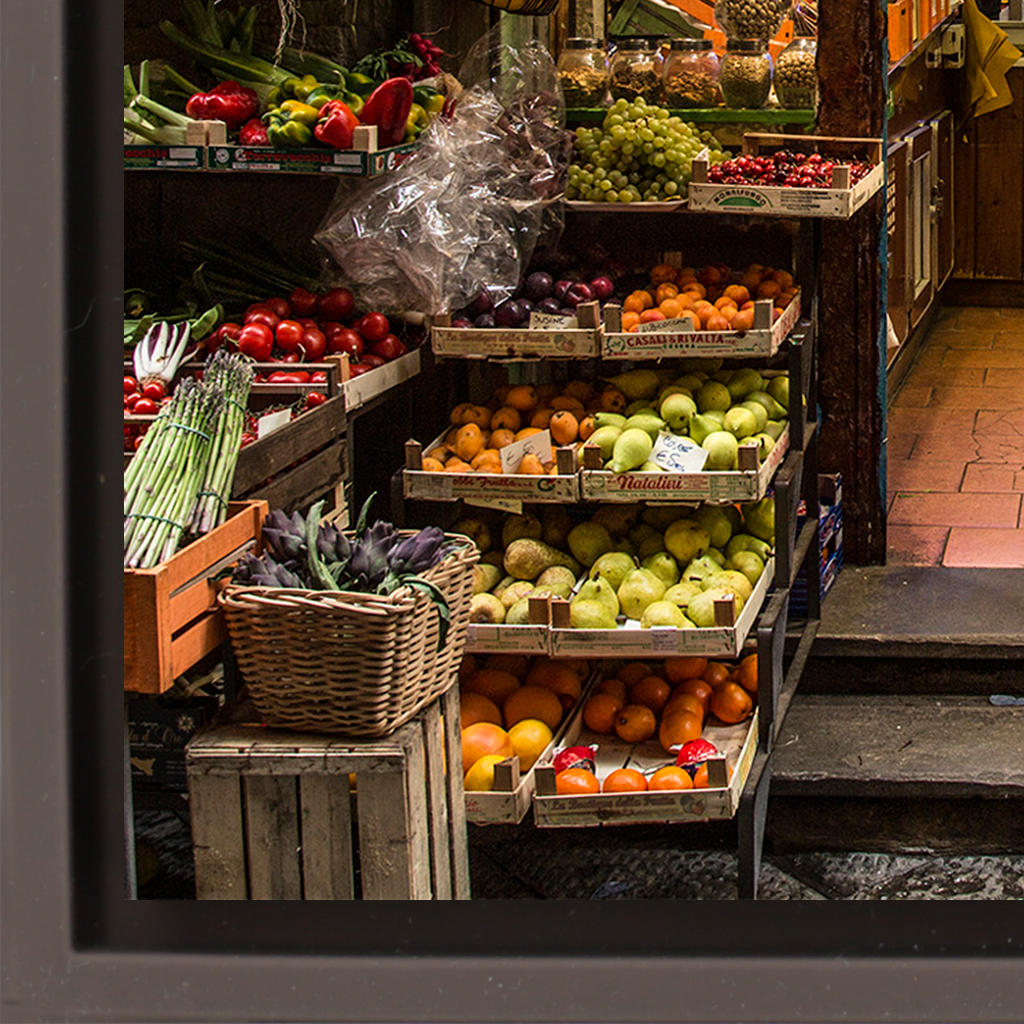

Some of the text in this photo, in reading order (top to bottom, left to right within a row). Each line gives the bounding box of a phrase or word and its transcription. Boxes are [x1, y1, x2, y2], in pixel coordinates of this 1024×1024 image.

[627, 334, 667, 348] CASALI
[677, 333, 725, 345] RIVALTA
[618, 474, 683, 491] Natalini
